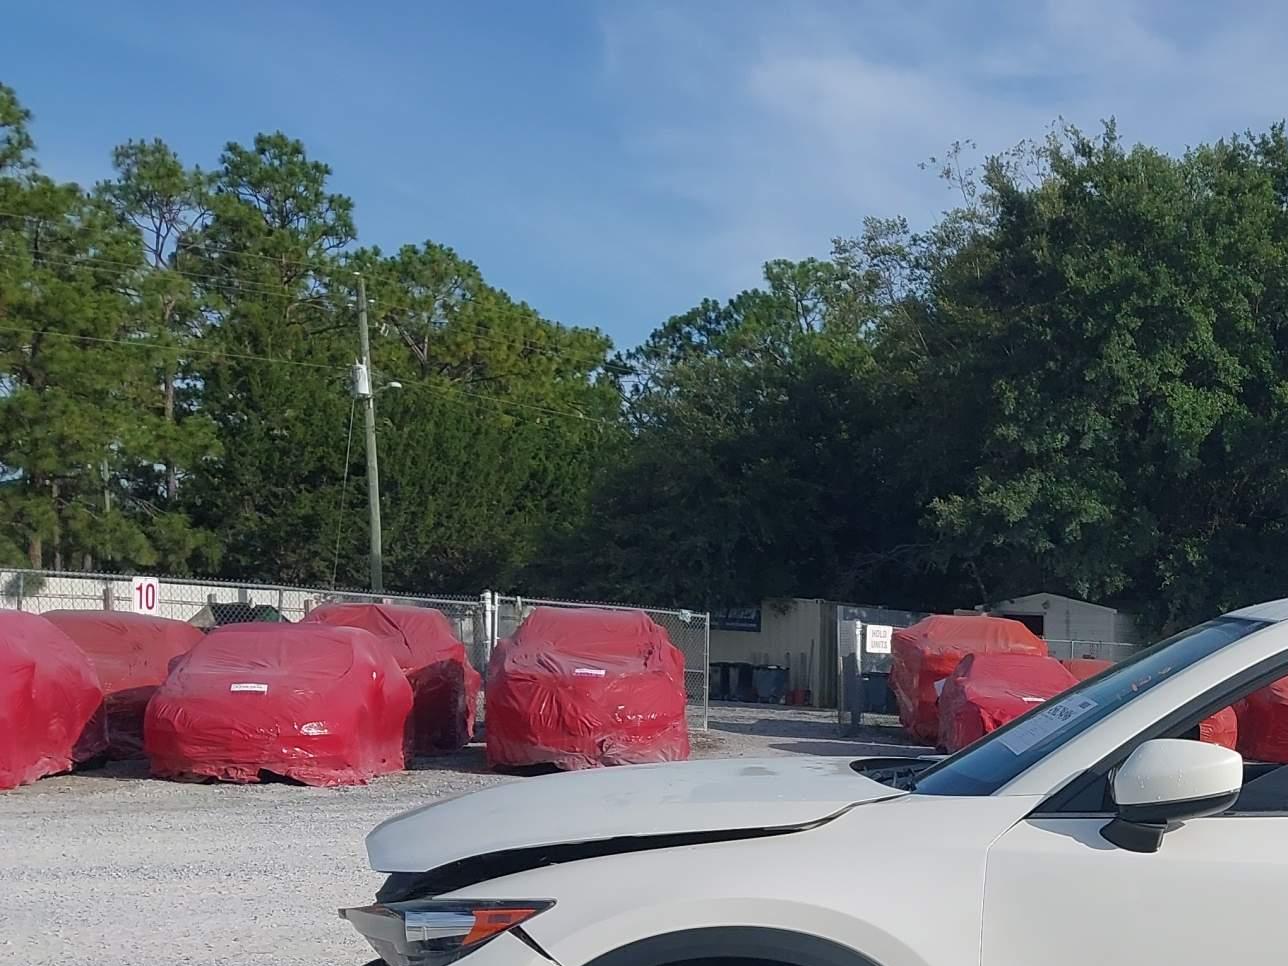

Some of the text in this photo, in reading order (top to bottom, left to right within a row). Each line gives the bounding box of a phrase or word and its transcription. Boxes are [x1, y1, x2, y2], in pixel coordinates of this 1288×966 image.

[135, 583, 155, 610] 10
[871, 629, 887, 638] HOLD
[871, 640, 888, 649] UNITS
